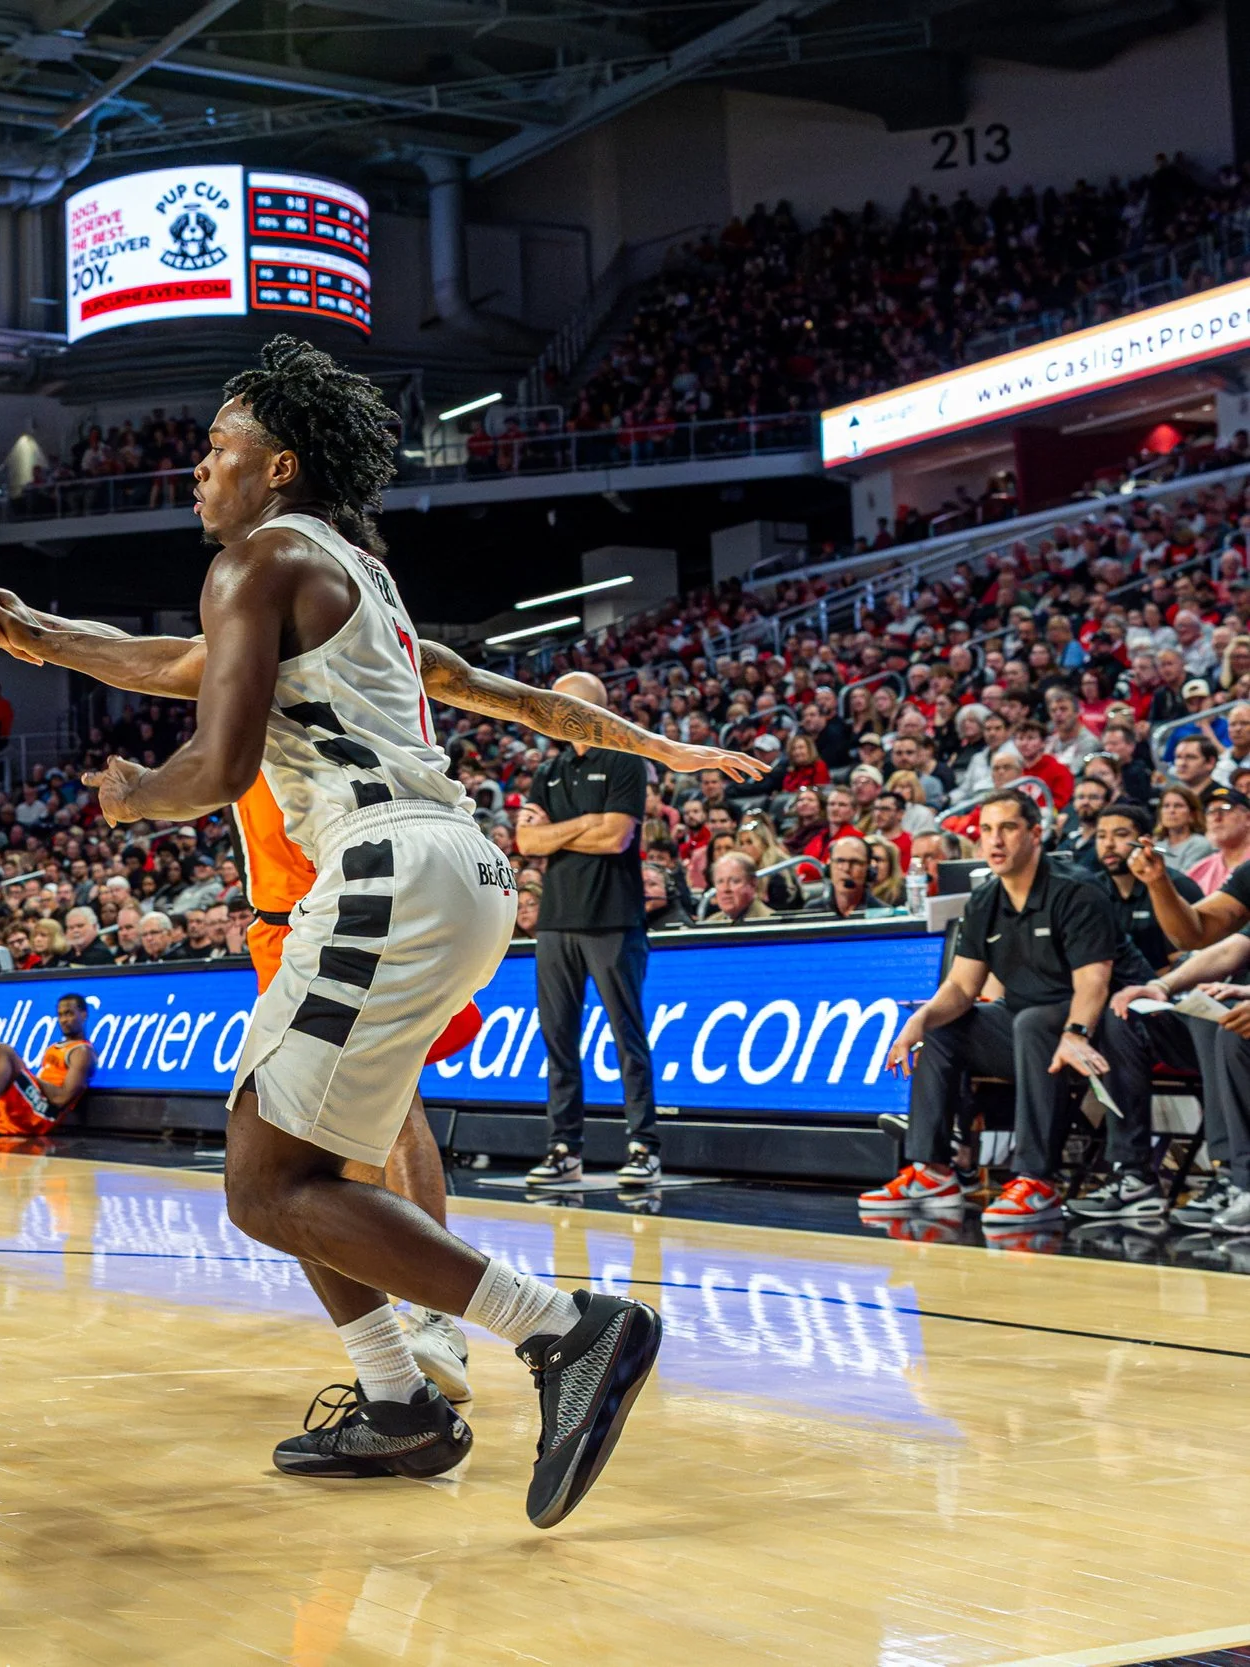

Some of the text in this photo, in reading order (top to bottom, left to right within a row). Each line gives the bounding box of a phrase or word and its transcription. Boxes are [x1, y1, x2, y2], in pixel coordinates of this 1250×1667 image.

[931, 122, 1012, 171] 213
[155, 181, 230, 215] PUP CUP
[89, 236, 151, 262] DELIVER
[72, 260, 113, 297] JOY.
